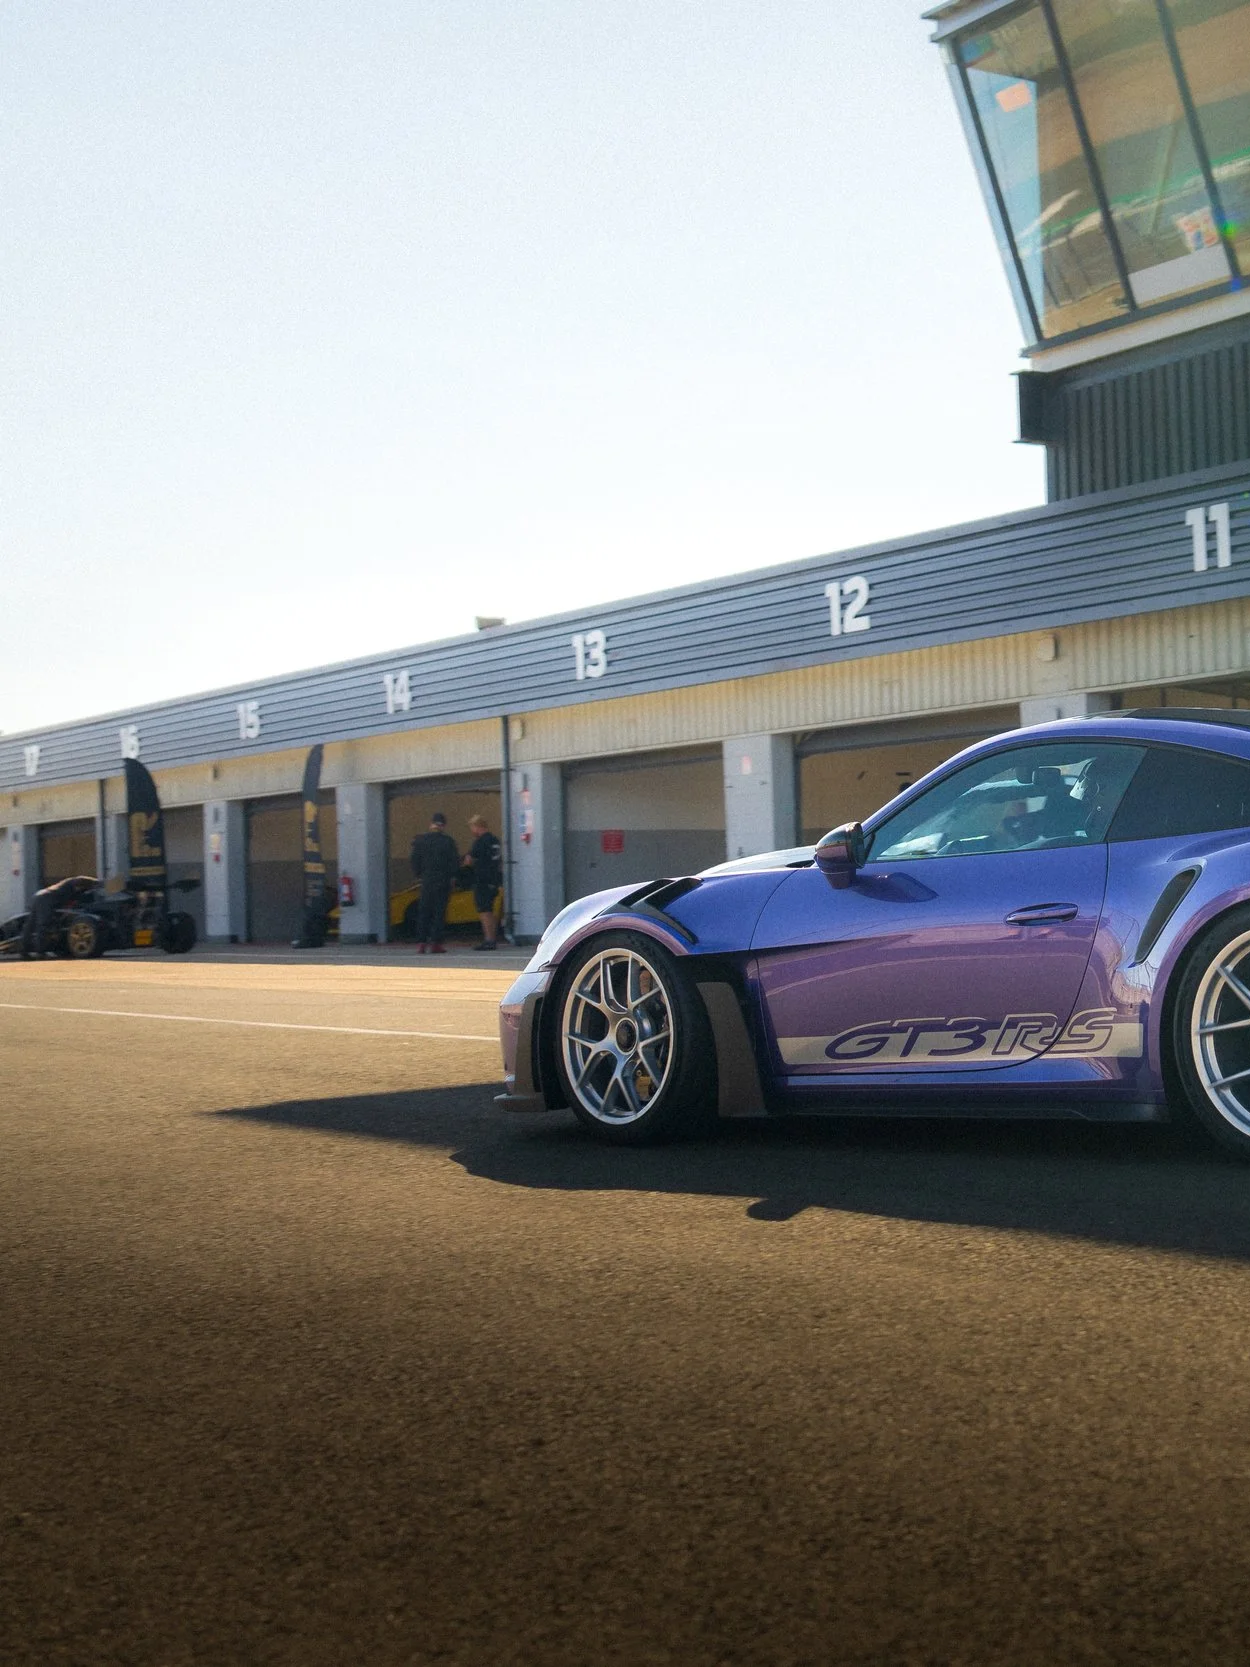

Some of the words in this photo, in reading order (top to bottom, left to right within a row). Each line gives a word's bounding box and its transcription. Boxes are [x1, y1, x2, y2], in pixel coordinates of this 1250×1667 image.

[1185, 502, 1231, 572] 11
[825, 576, 871, 636] 12
[571, 630, 607, 680] 13
[383, 670, 411, 714] 14
[120, 725, 139, 759] 16
[236, 701, 260, 739] 15
